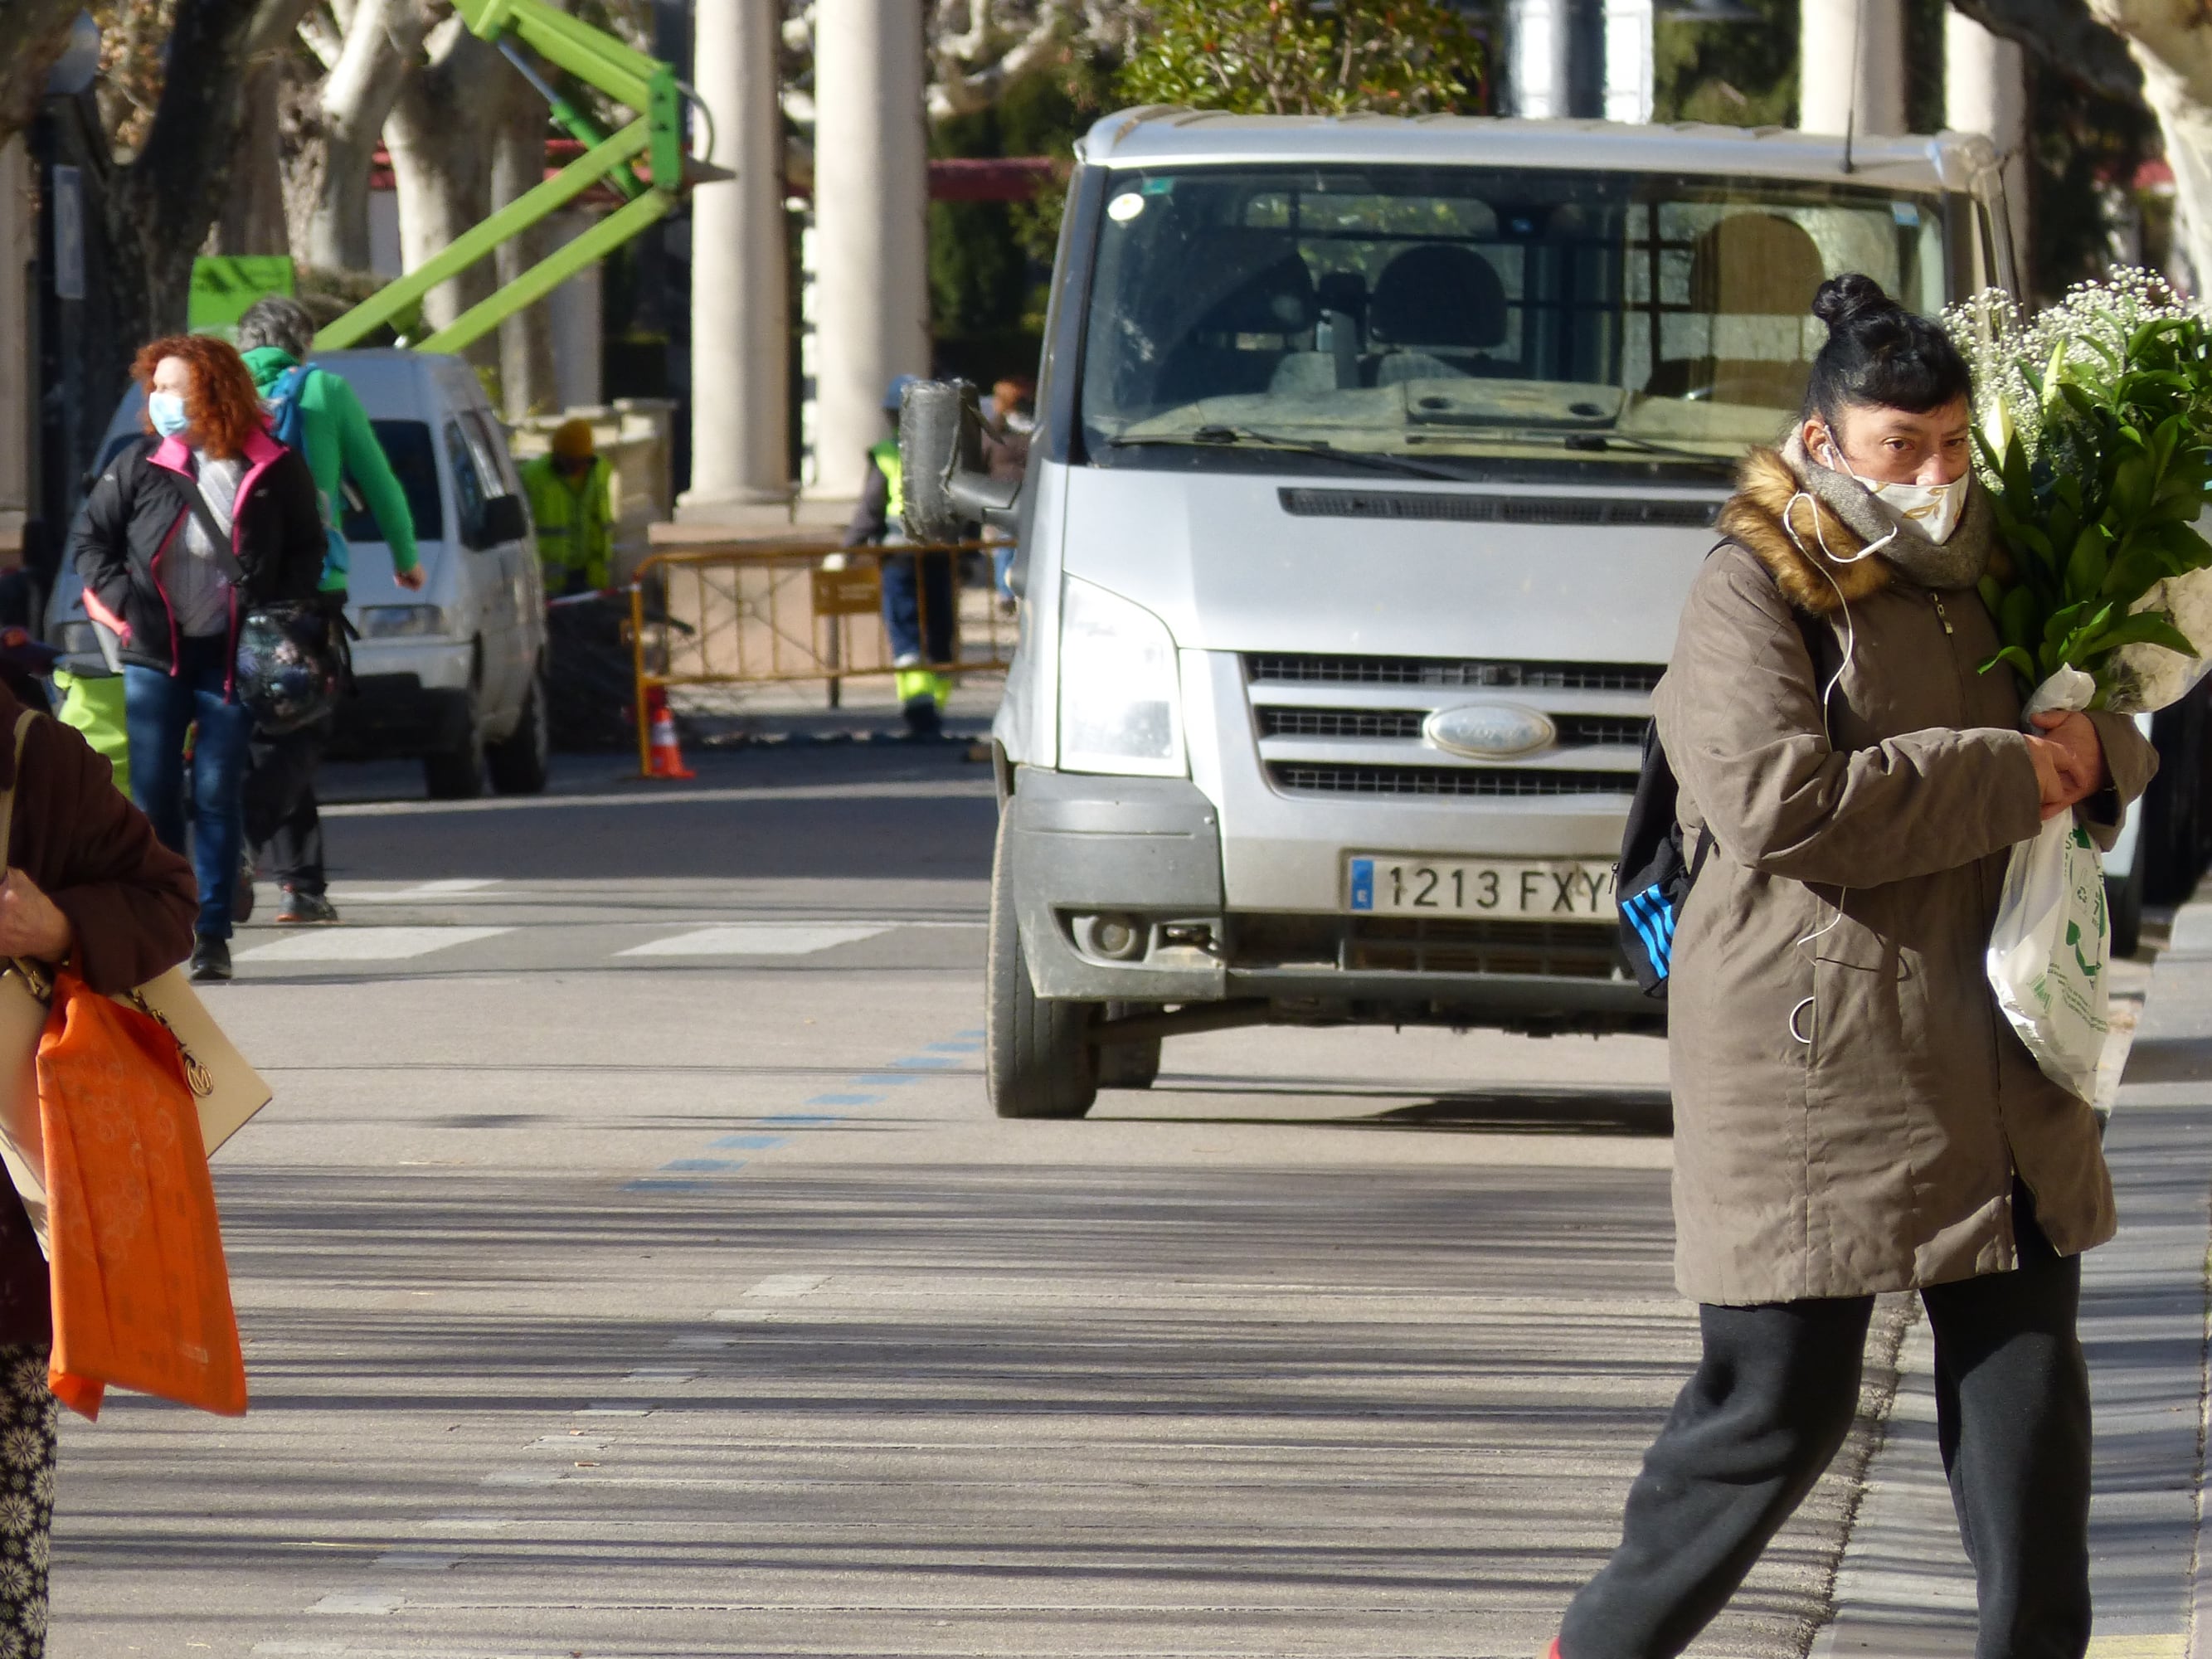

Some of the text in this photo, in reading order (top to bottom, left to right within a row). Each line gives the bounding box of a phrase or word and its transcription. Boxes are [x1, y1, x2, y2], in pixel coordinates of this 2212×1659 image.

[1358, 889, 1368, 902] E
[1389, 866, 1607, 912] 1213 FXY
